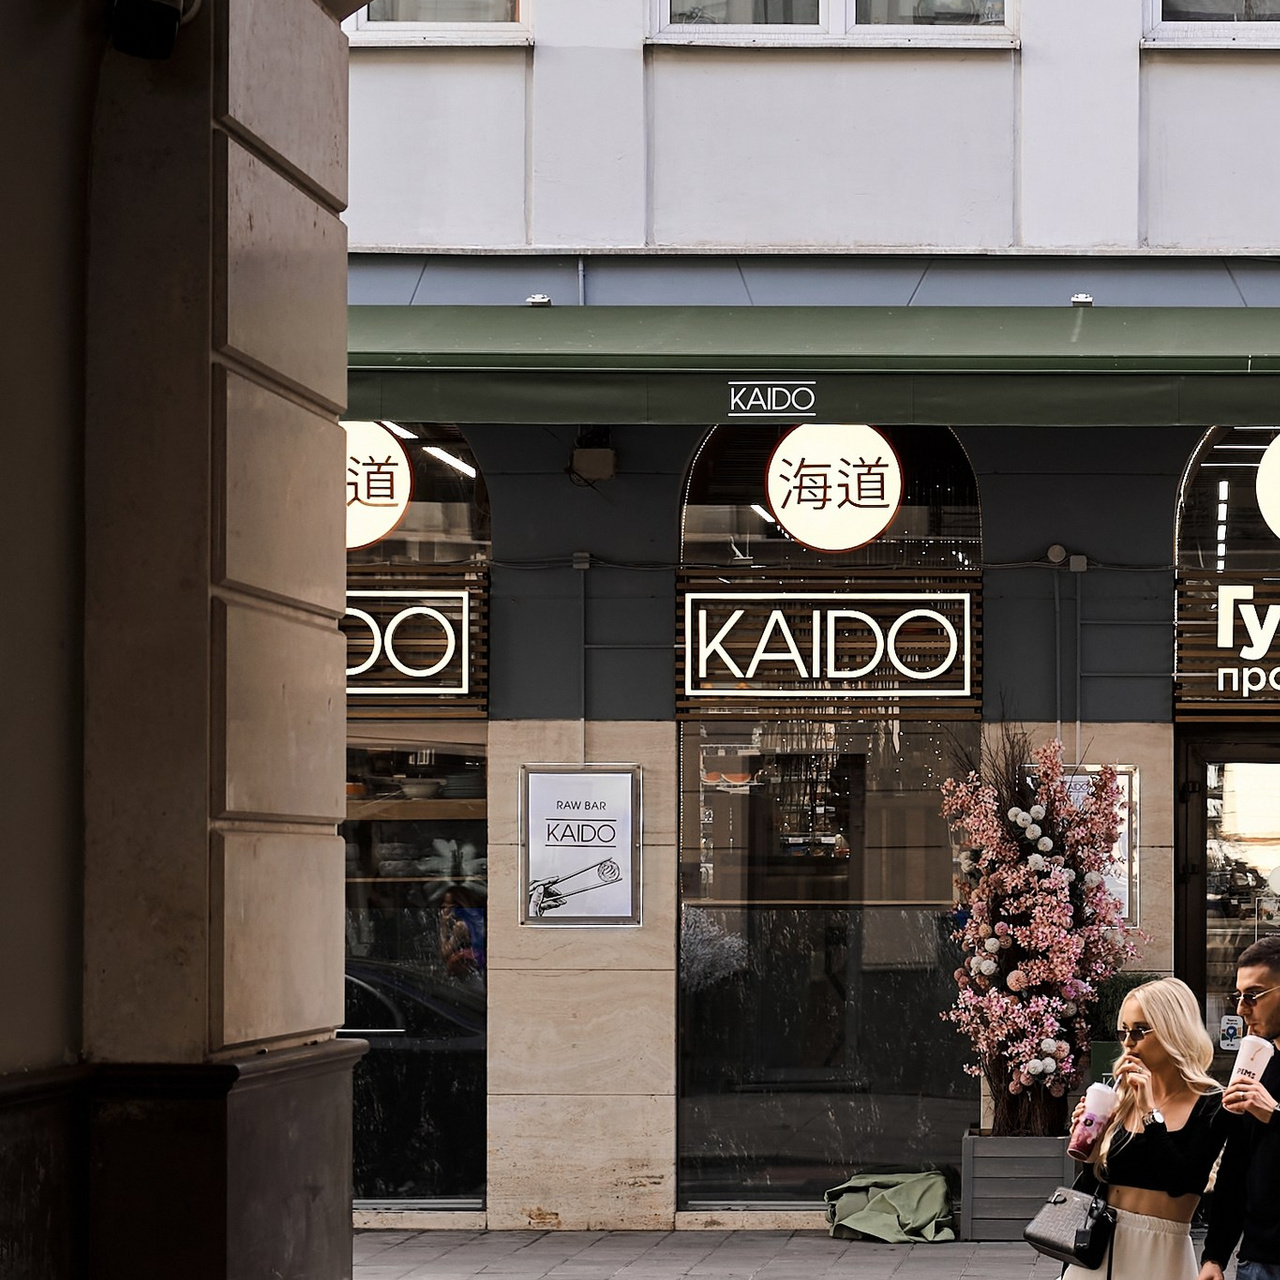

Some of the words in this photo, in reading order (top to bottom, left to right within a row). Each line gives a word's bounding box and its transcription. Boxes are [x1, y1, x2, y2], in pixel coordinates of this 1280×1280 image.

[729, 386, 815, 411] KAIDO
[779, 456, 890, 510] 海道
[698, 608, 958, 680] KAIDO
[556, 800, 581, 810] RAW
[584, 800, 607, 810] BAR
[547, 823, 616, 843] KAIDO
